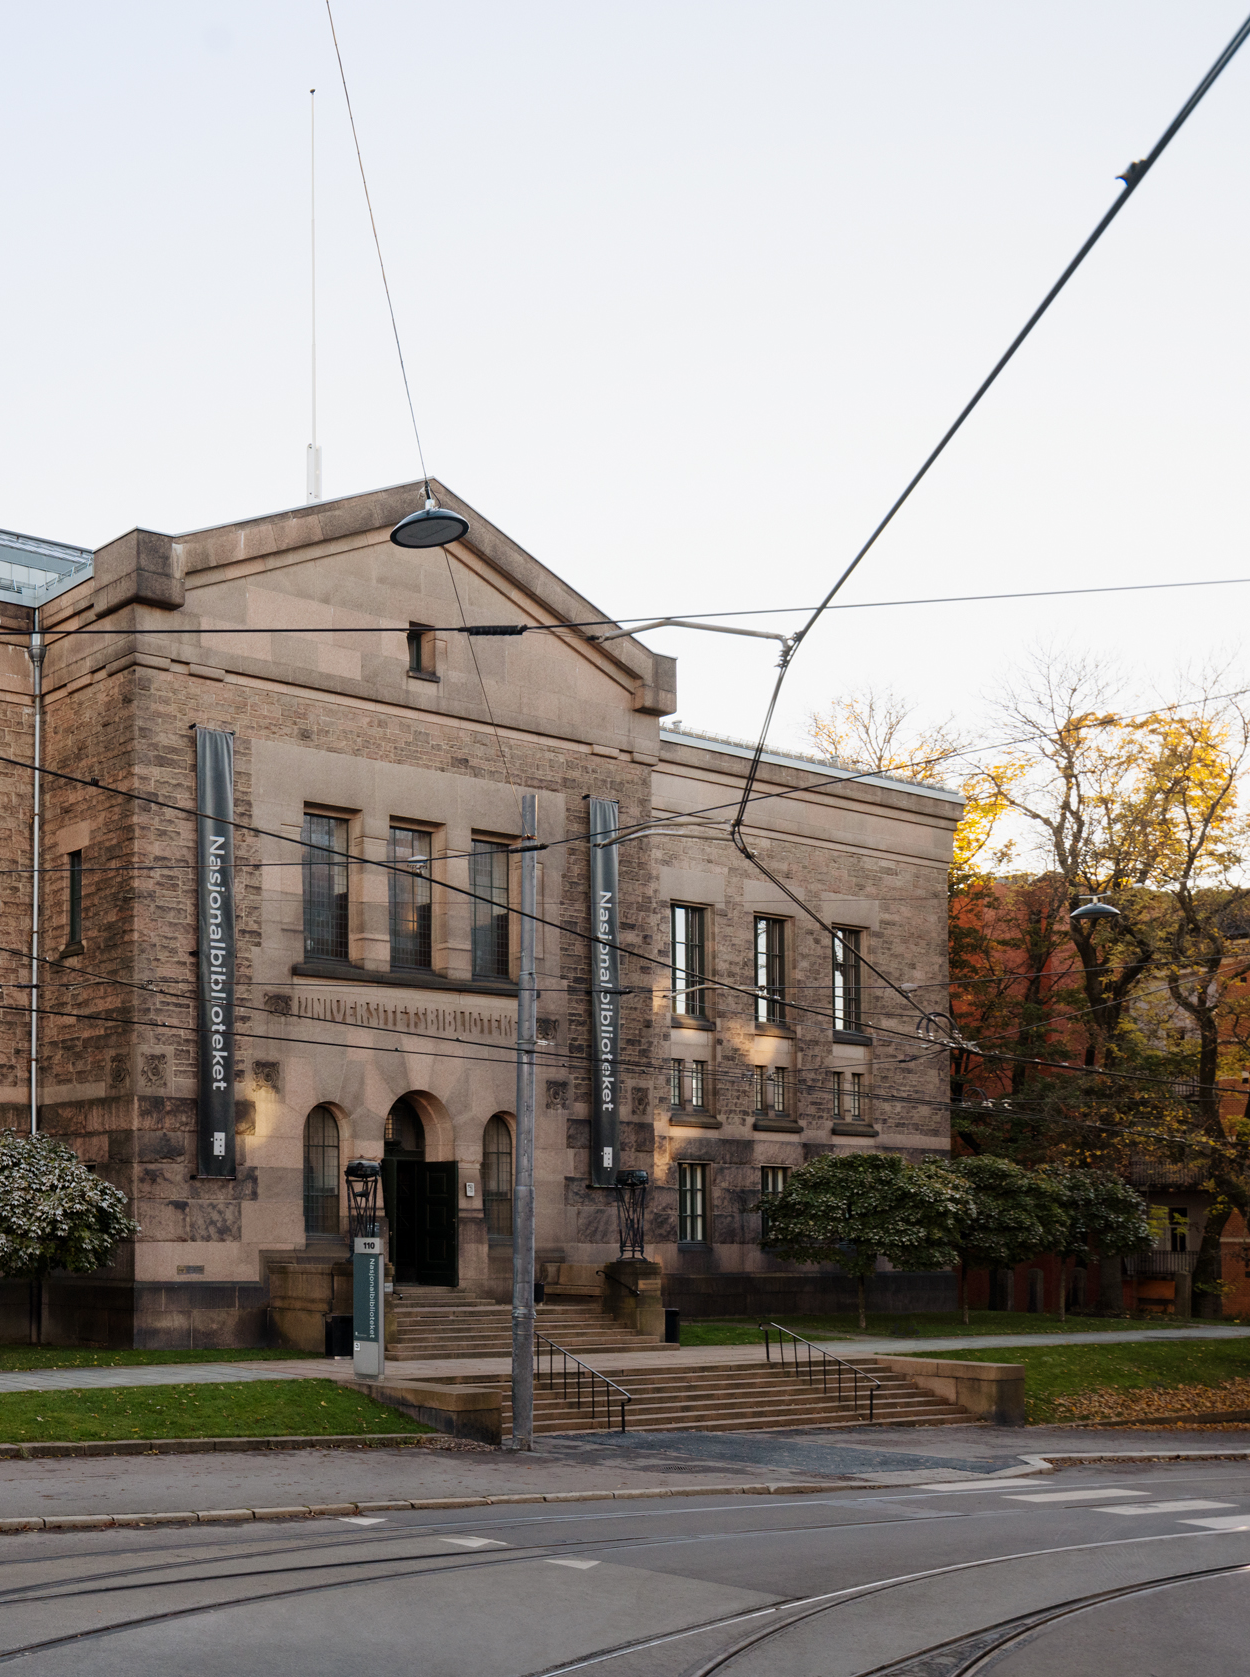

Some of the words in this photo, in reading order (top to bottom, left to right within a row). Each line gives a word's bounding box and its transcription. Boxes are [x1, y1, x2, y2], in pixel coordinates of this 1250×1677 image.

[207, 835, 228, 1092] Nasjonalbiblioteket
[298, 996, 519, 1036] UNIVERSITETSBIBLIOTEKE
[598, 890, 615, 1112] Nasjonalbiblioteket
